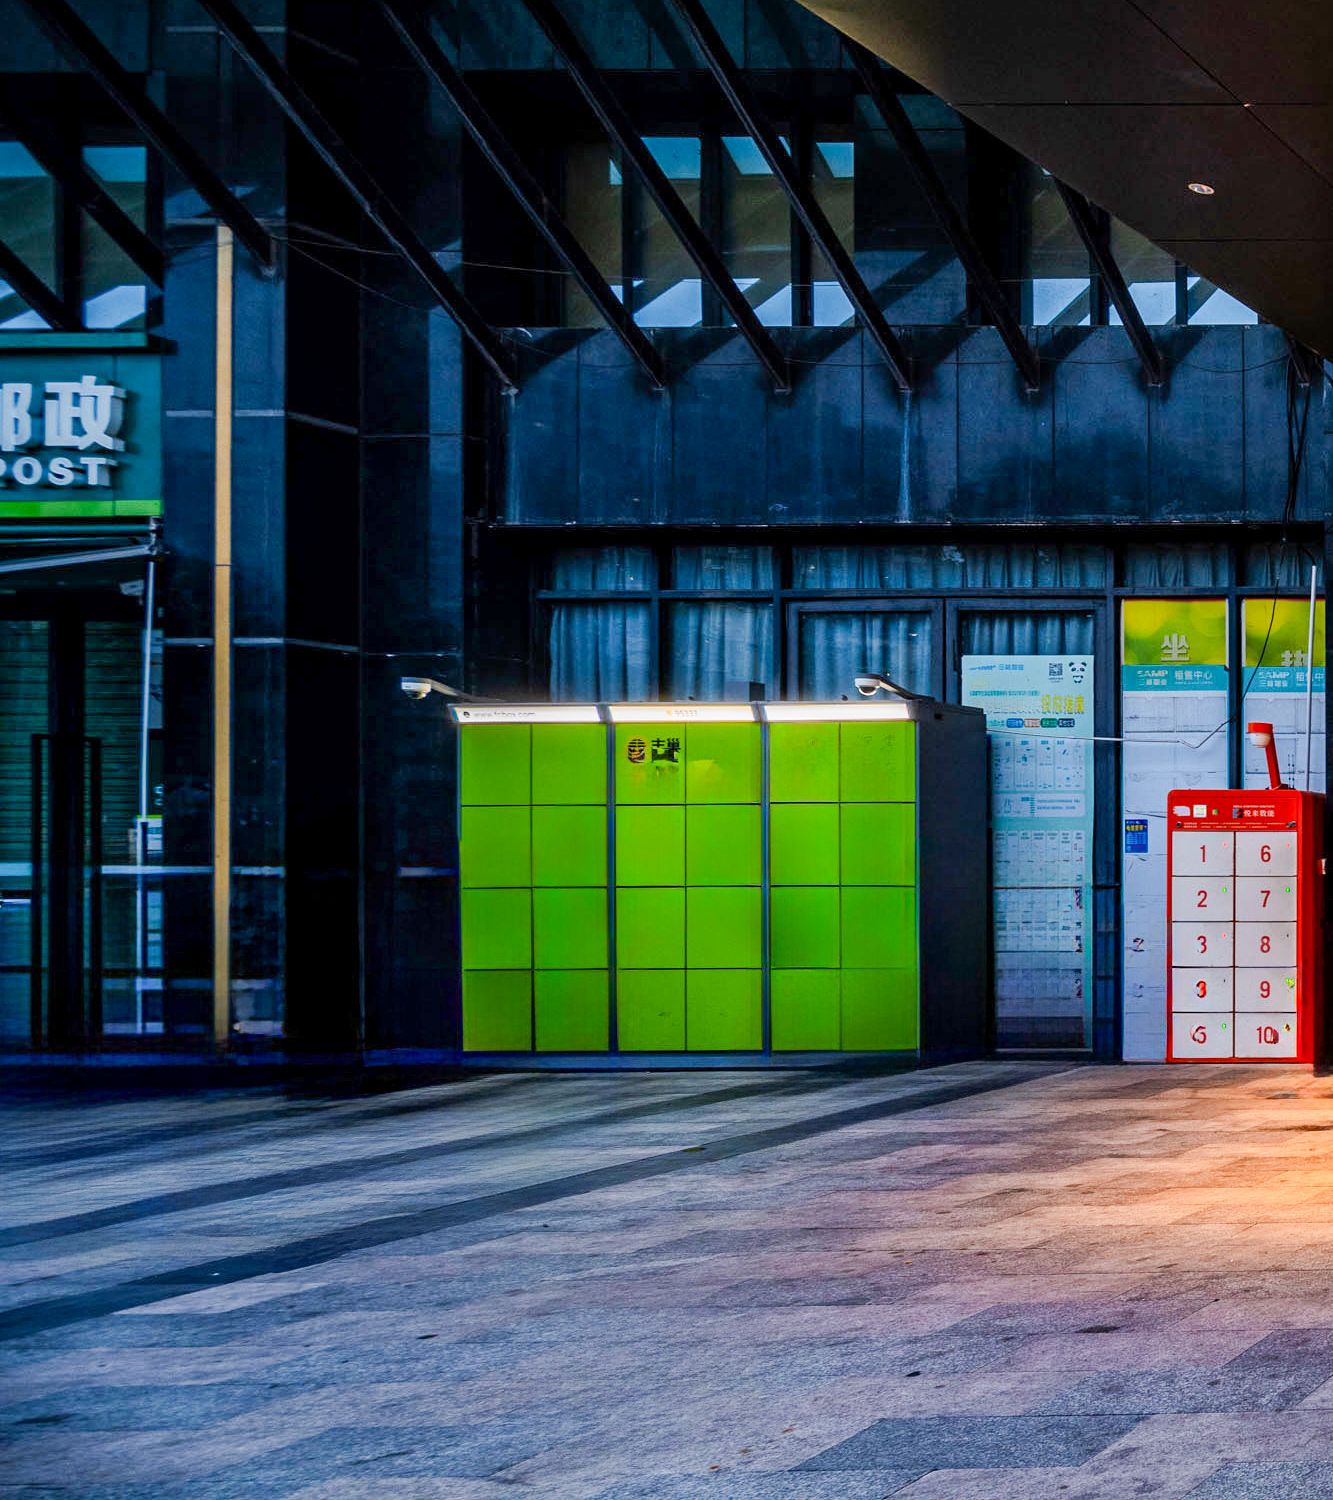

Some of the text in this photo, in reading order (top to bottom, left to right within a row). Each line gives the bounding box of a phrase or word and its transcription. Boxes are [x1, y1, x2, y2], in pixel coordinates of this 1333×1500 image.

[0, 456, 118, 487] OST
[1200, 844, 1206, 863] 1
[1260, 844, 1271, 863] 6
[1197, 890, 1208, 908] 2
[1260, 890, 1271, 908] 7
[1197, 935, 1207, 954] 3
[1260, 935, 1271, 953] 8
[1260, 980, 1271, 999] 9
[1256, 1026, 1275, 1044] 10
